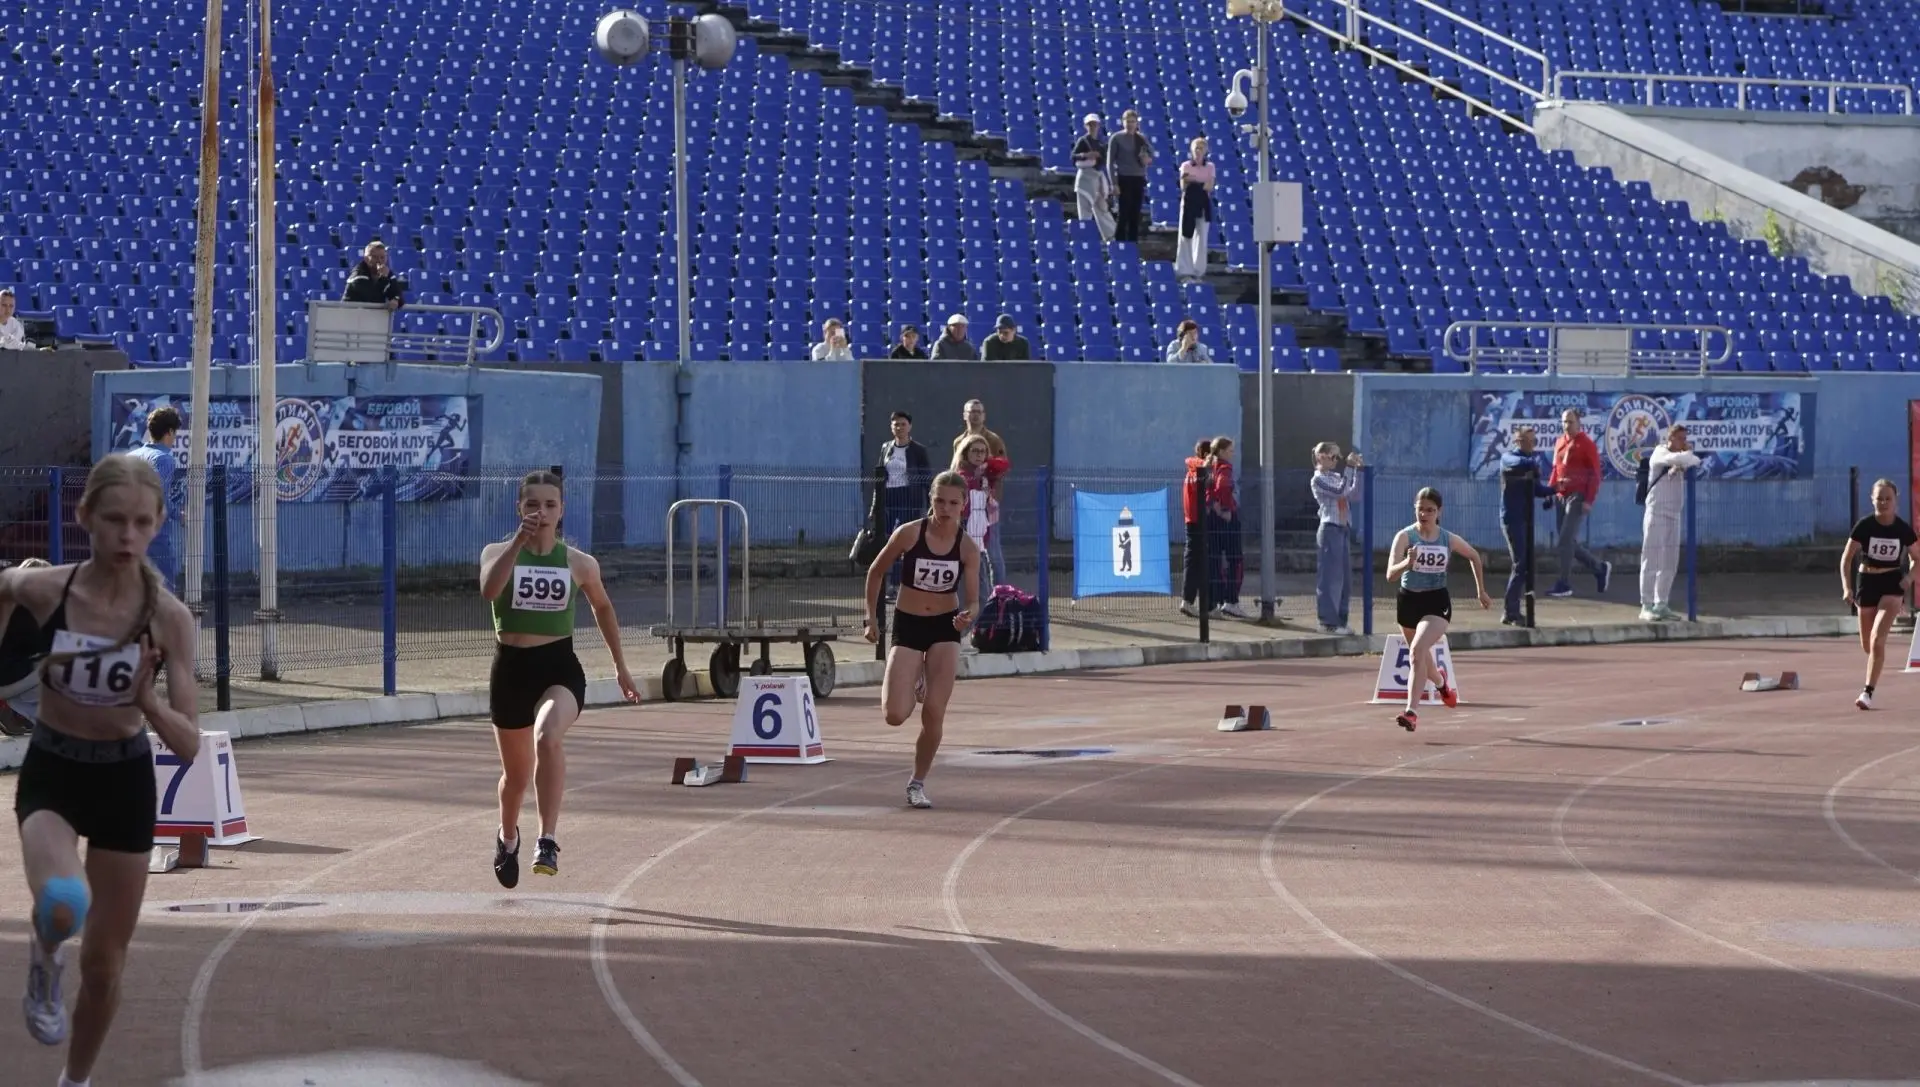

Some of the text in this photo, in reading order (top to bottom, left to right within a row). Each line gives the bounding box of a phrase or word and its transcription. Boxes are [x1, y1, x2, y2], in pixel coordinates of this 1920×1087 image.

[367, 400, 420, 415] БЕГОВОЙ
[1534, 393, 1587, 406] БЕГОВОЙ
[1707, 393, 1759, 407] БЕГОВОЙ
[279, 404, 316, 430] ЛИМП
[1616, 400, 1663, 420] ОЛИМП
[1726, 408, 1758, 419] КЛУБ
[385, 416, 420, 429] КЛУБ
[1741, 425, 1773, 435] КЛУБ
[338, 432, 434, 449] БЕГОВОЙ КЛУБ
[352, 451, 419, 465] "ОЛИМП"
[1872, 544, 1897, 555] 187
[1417, 553, 1445, 566] 482
[919, 568, 954, 584] 719
[518, 577, 566, 600] 599
[62, 656, 133, 693] 116
[753, 693, 782, 740] 6
[803, 693, 814, 739] 6
[156, 755, 194, 814] 7
[217, 753, 231, 813] 7
